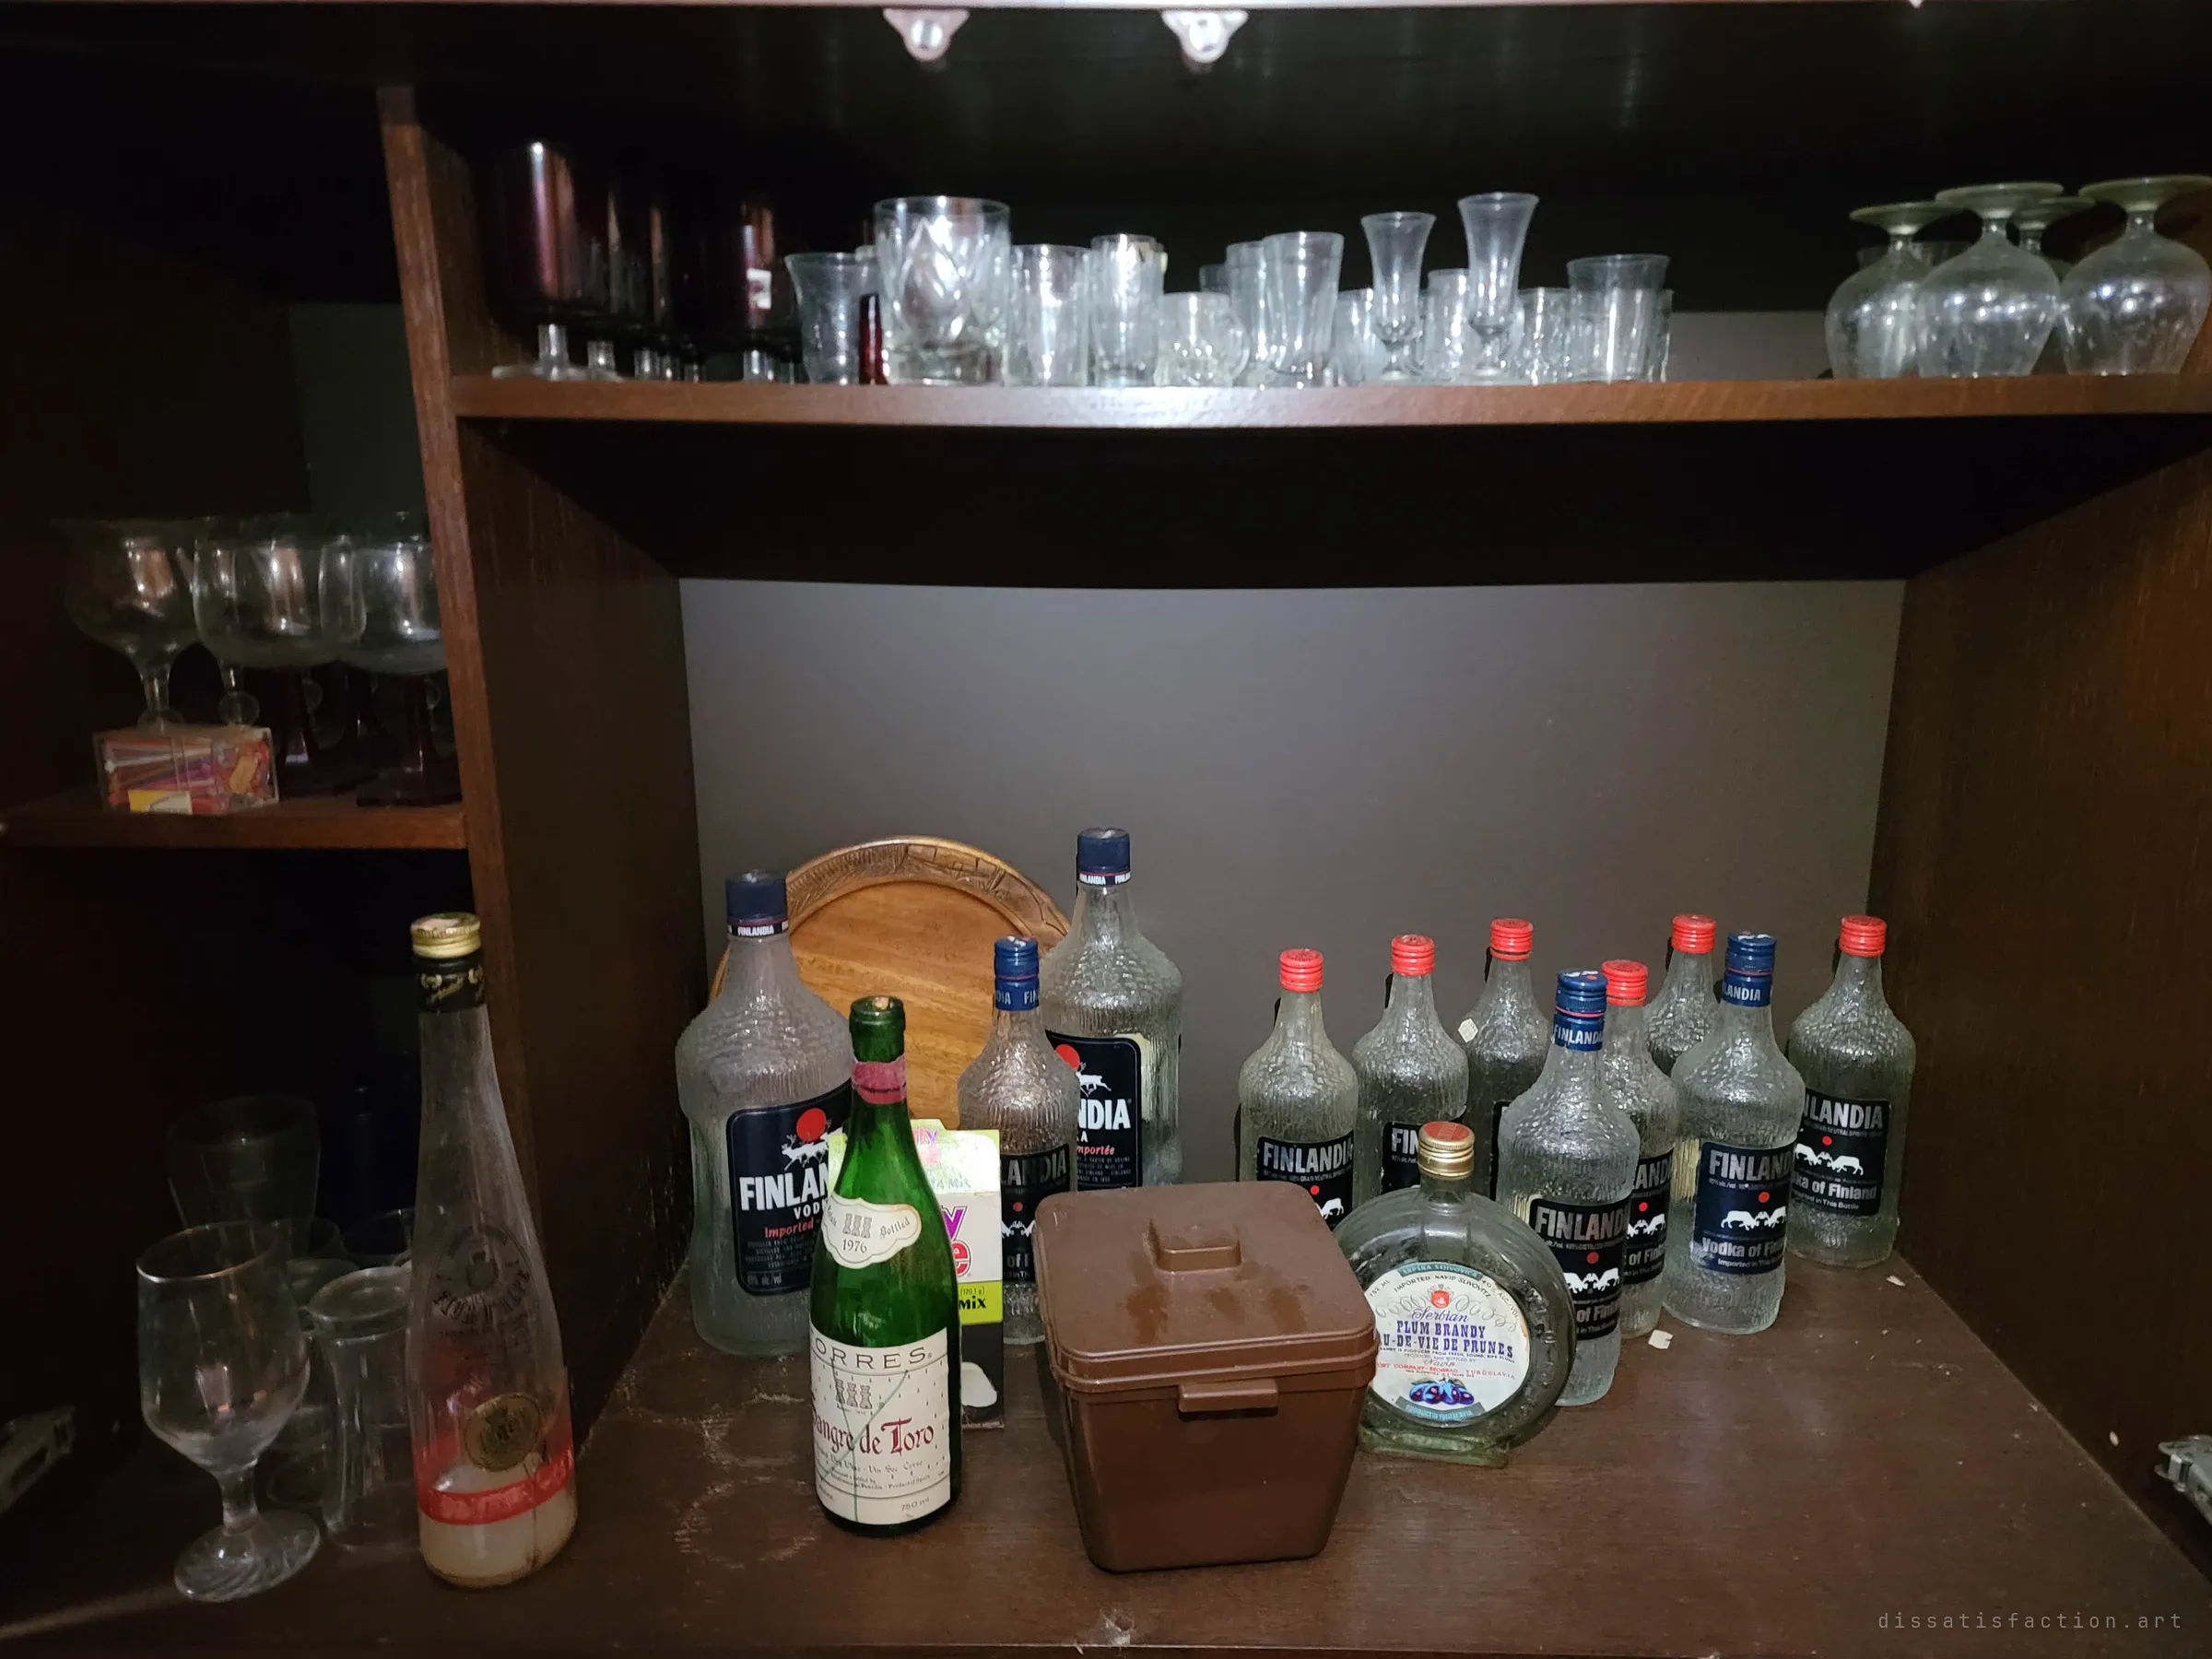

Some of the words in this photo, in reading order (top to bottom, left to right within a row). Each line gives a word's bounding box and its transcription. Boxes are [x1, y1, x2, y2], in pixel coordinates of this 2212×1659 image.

[738, 924, 774, 936] FINLANDIA
[1811, 1180, 1826, 1194] of
[1829, 1182, 1877, 1200] Finland
[764, 1217, 814, 1238] Imported
[879, 1217, 911, 1239] Bottled
[842, 1239, 867, 1254] 1976
[1702, 1237, 1745, 1258] Vodka
[1394, 1277, 1430, 1294] IMPORTED
[1412, 1306, 1468, 1324] Serbian
[1397, 1320, 1430, 1335] PLUM
[1435, 1323, 1486, 1339] BRANDY
[812, 1327, 925, 1370] ORRES
[1380, 1334, 1439, 1350] U-DE-VIE
[1443, 1338, 1458, 1351] DE
[1464, 1338, 1513, 1359] PRUNES
[860, 1423, 882, 1454] de
[882, 1418, 934, 1456] Toro
